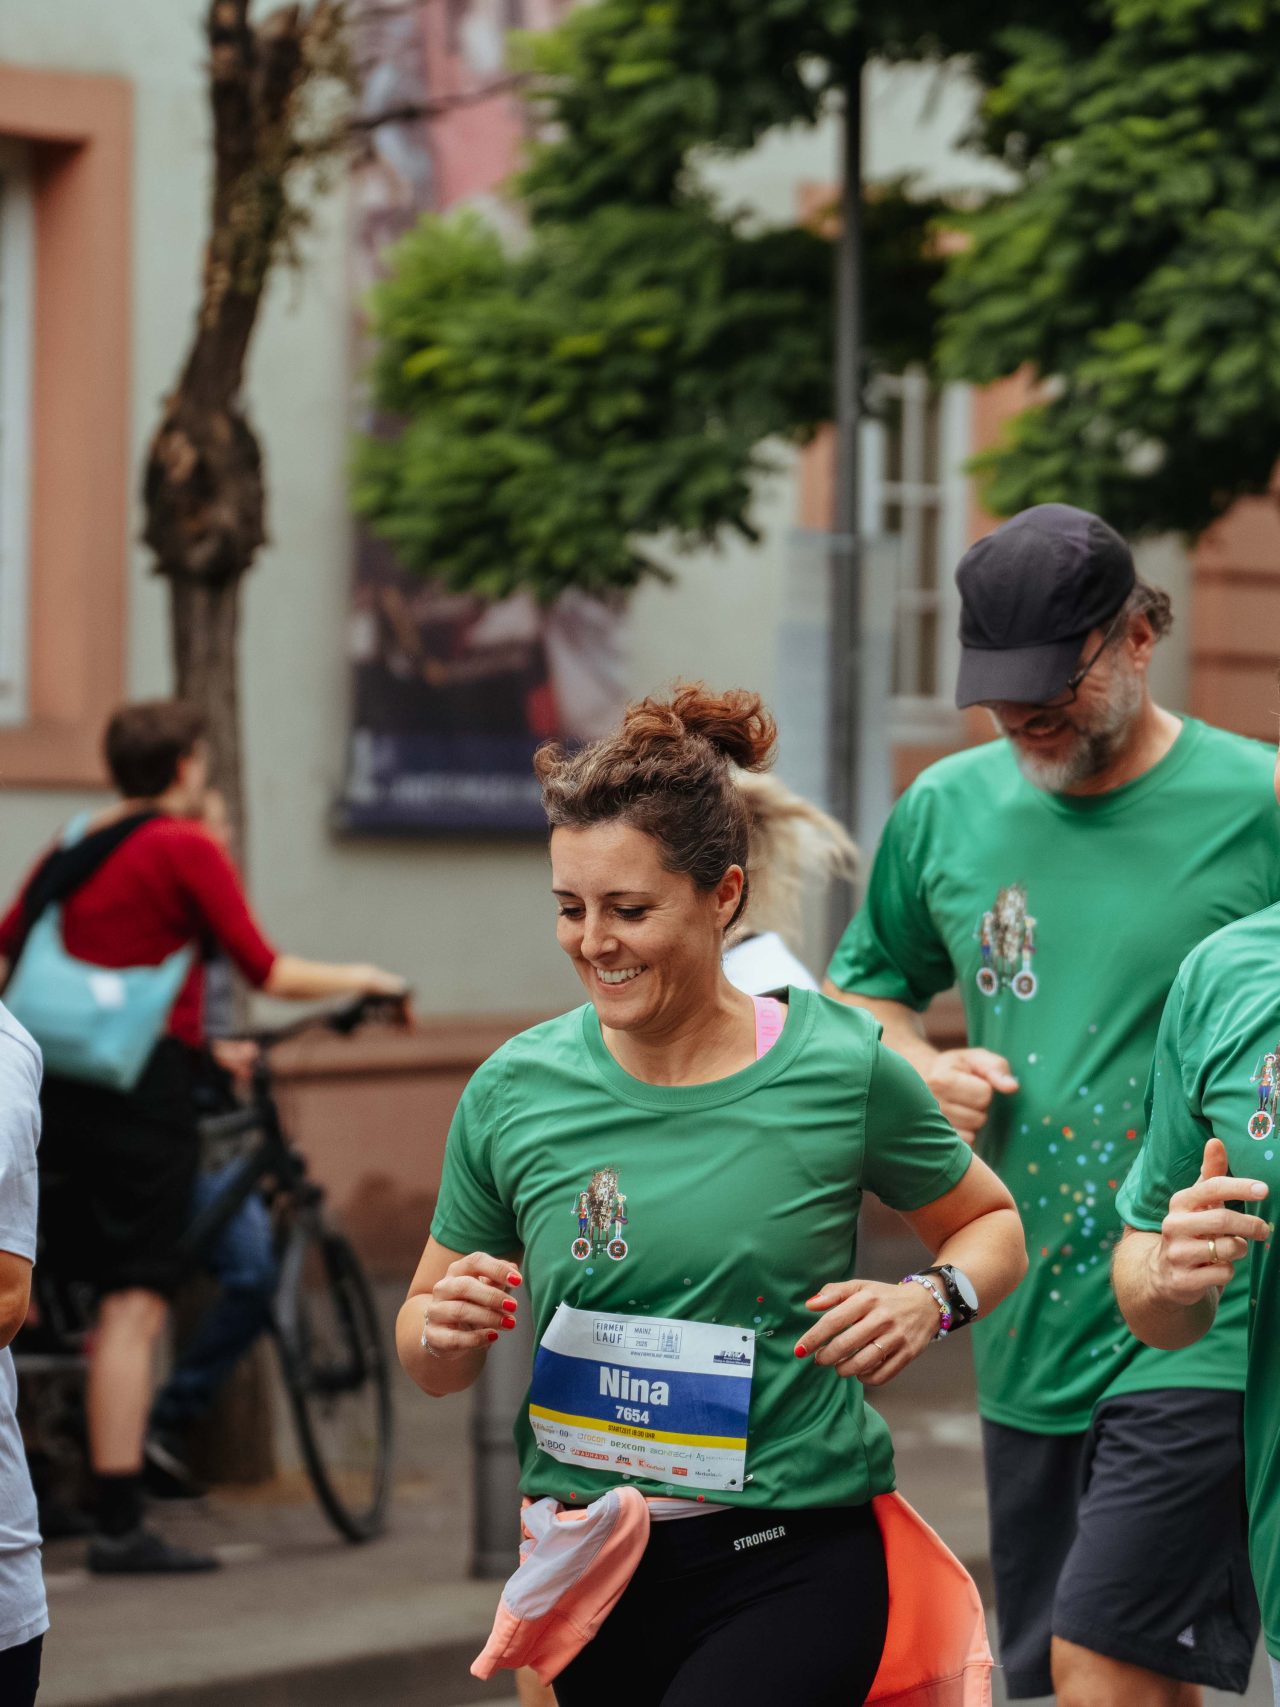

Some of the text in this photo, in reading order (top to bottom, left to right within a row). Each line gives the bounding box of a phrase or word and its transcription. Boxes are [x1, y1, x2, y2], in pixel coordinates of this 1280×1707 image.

[596, 1322, 624, 1332] FIRMEN
[634, 1327, 652, 1335] MAINZ
[596, 1331, 623, 1344] LAUF
[599, 1366, 670, 1406] Nina
[615, 1405, 650, 1425] 7654
[547, 1439, 566, 1451] BDO
[616, 1454, 630, 1463] dm
[733, 1525, 787, 1551] STRONGER
